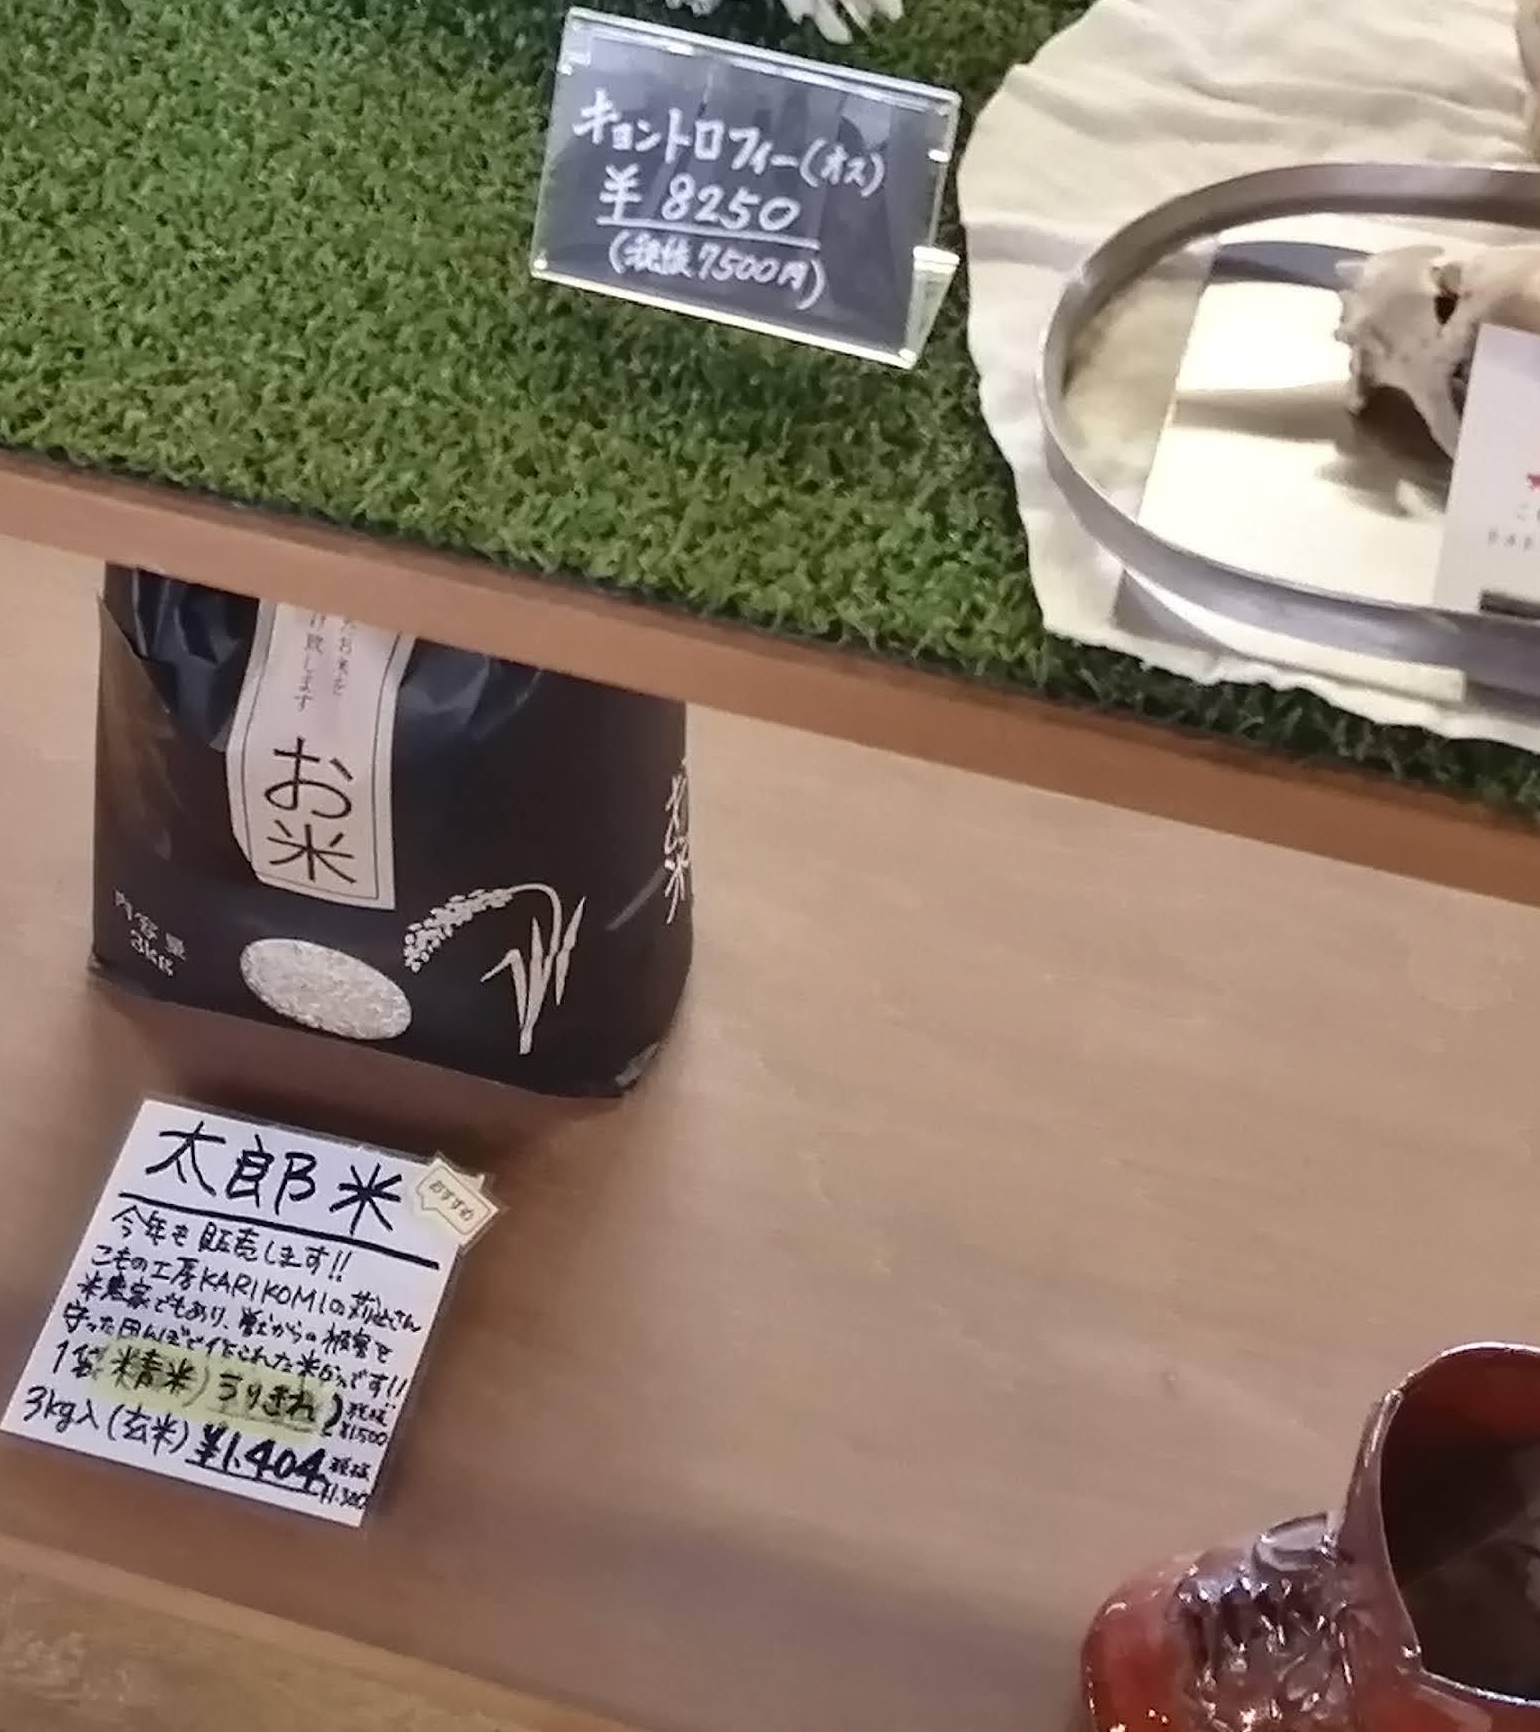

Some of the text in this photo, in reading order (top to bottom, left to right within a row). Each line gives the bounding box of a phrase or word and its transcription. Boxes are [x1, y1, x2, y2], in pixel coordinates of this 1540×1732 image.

[263, 736, 357, 886] お米
[145, 1120, 403, 1235] 太郎米
